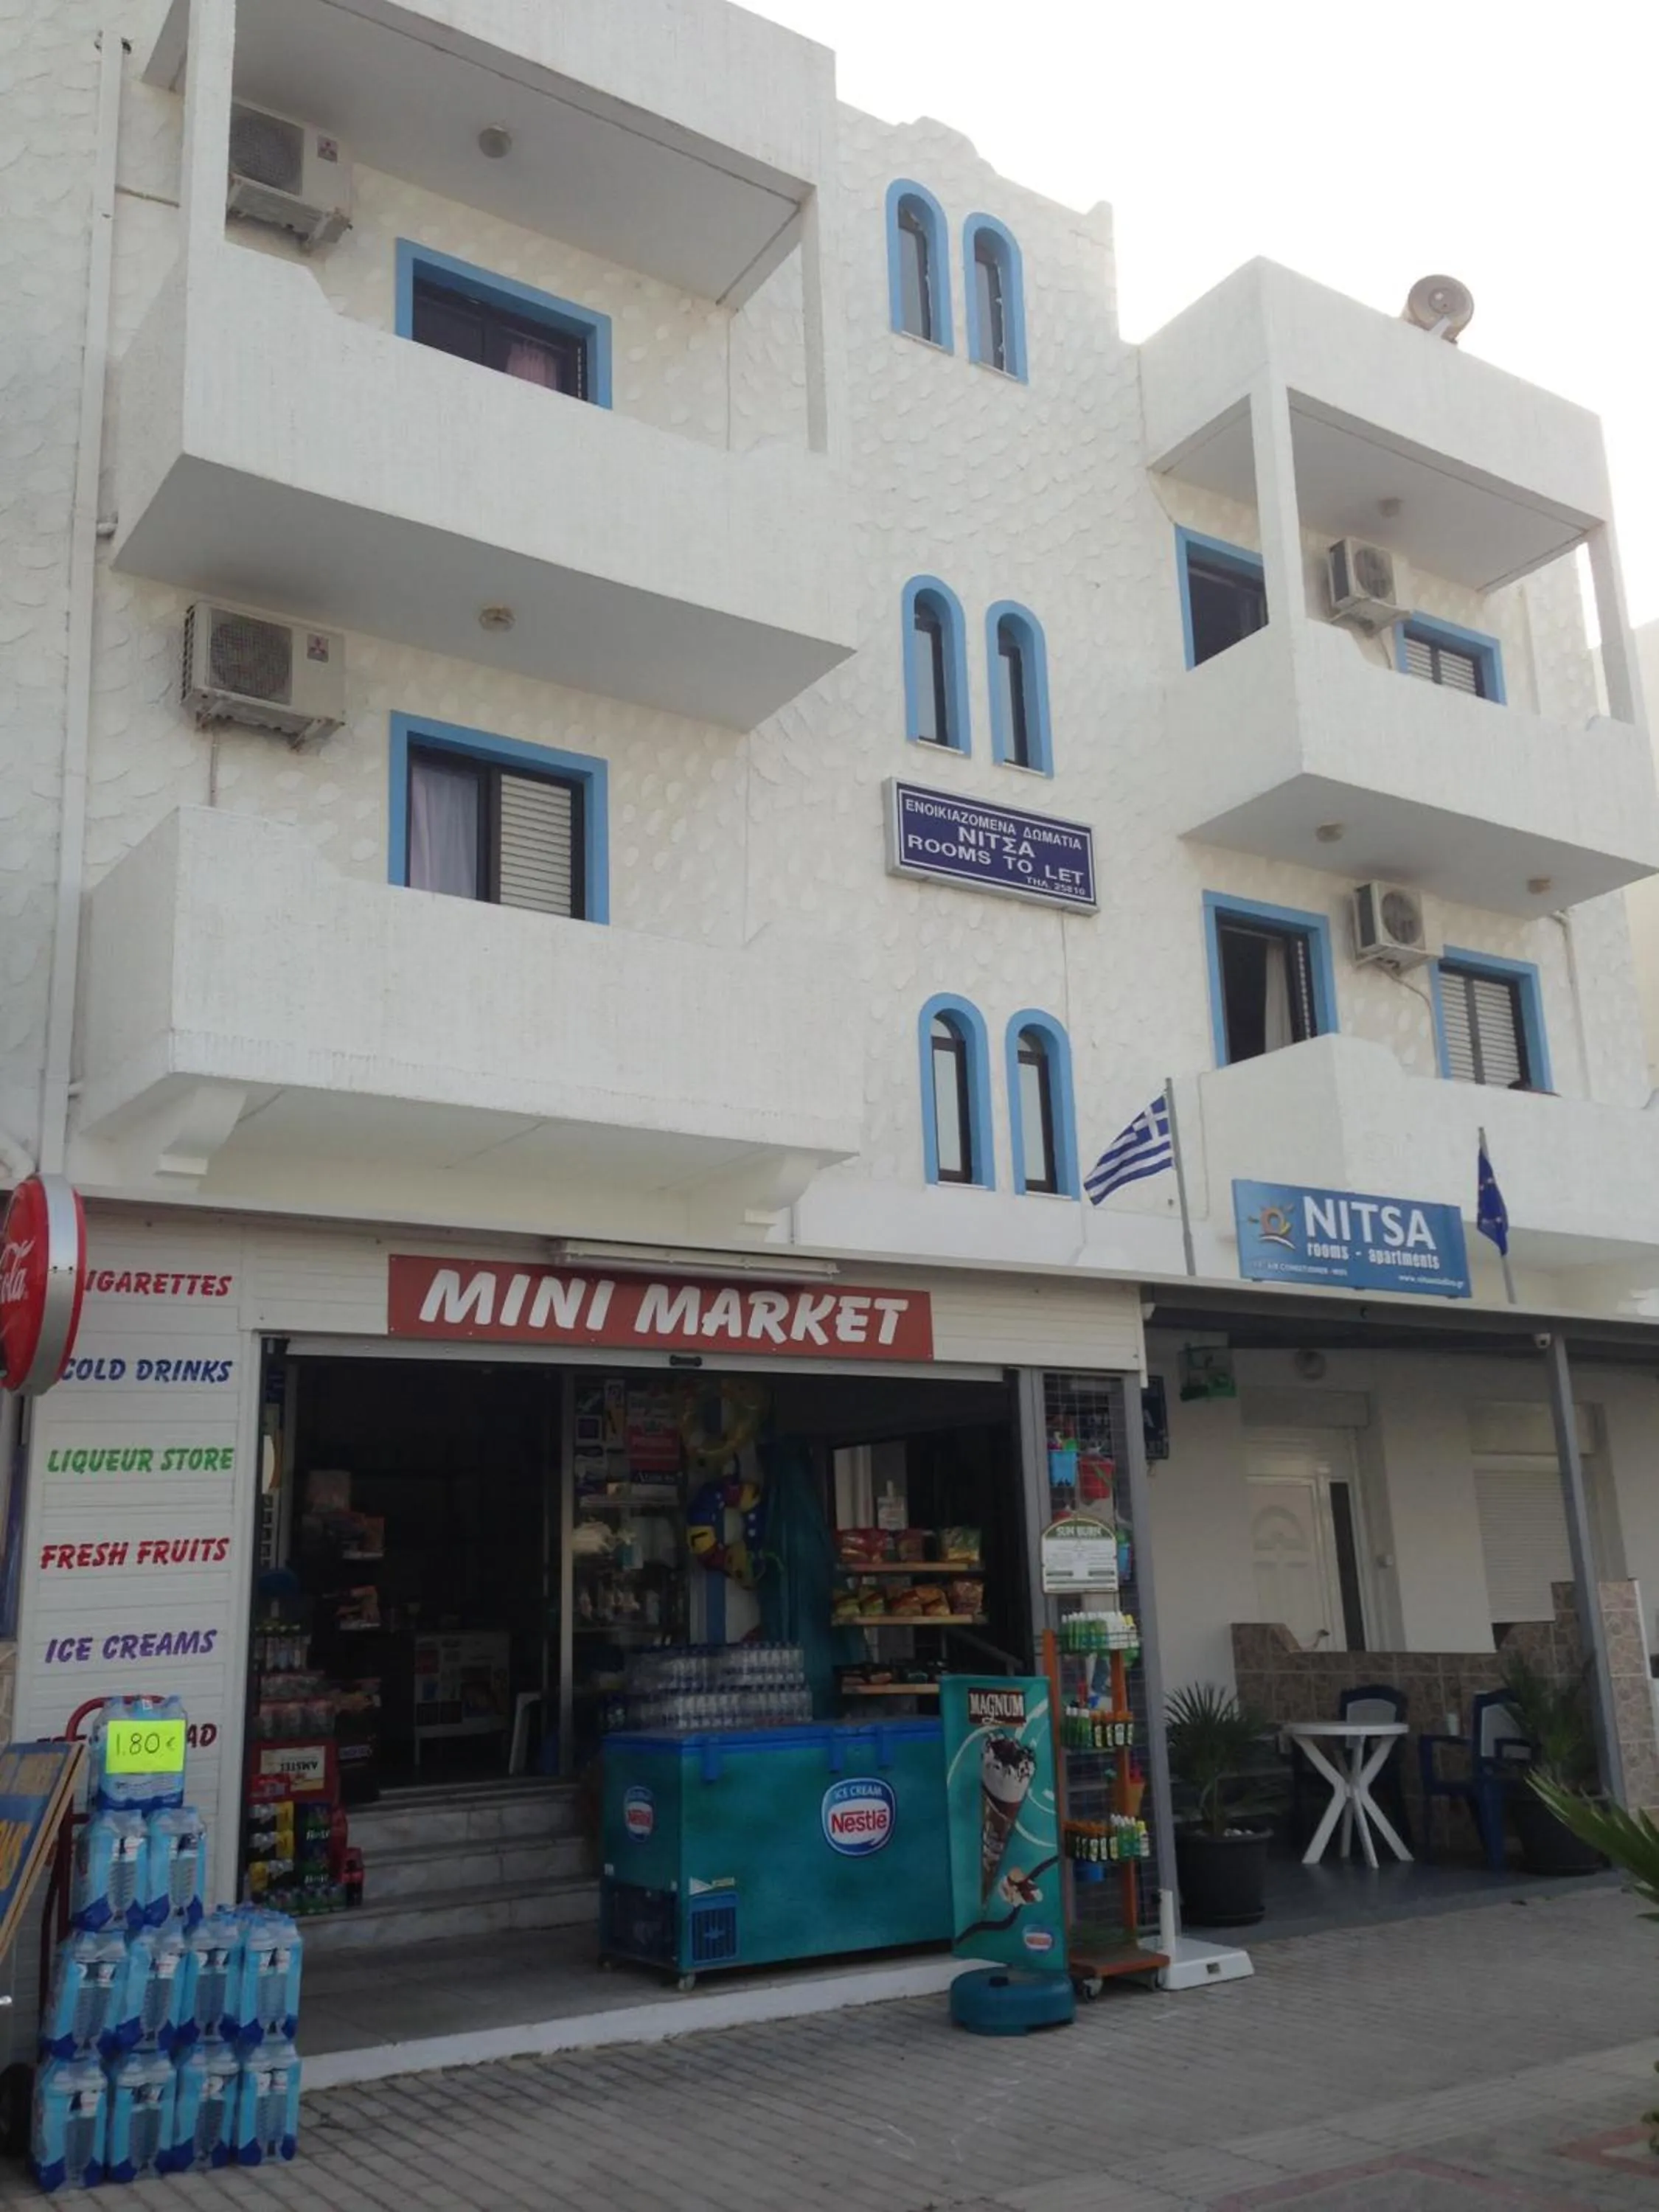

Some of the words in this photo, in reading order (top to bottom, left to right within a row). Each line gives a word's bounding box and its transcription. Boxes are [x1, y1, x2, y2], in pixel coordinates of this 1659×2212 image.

[905, 799, 1017, 835] ΕΝΟΙΚΙΑΖΟΜΕΝΑ
[1023, 827, 1082, 849] ΔΩΜΑΤΙΑ
[959, 827, 1034, 858] ΝΙΤΣΑ
[908, 834, 991, 865] ROOMS
[1003, 856, 1033, 873] TO
[1045, 864, 1084, 884] LET
[1303, 1196, 1436, 1250] NITSA
[1307, 1242, 1349, 1260] rooms
[1368, 1248, 1439, 1270] apartments
[84, 1270, 232, 1296] IGARETTES
[420, 1268, 615, 1331] MINI
[634, 1284, 908, 1346] MARKET
[136, 1358, 233, 1383] DRINKS
[47, 1448, 153, 1474] LIQUEUR
[160, 1447, 234, 1471] STORE
[41, 1542, 129, 1569] FRESH
[136, 1537, 230, 1565] FRUITS
[45, 1636, 93, 1664] ICE
[102, 1630, 218, 1660] CREAMS
[970, 1693, 1024, 1722] MAGNUM
[850, 1785, 883, 1797] CREAM
